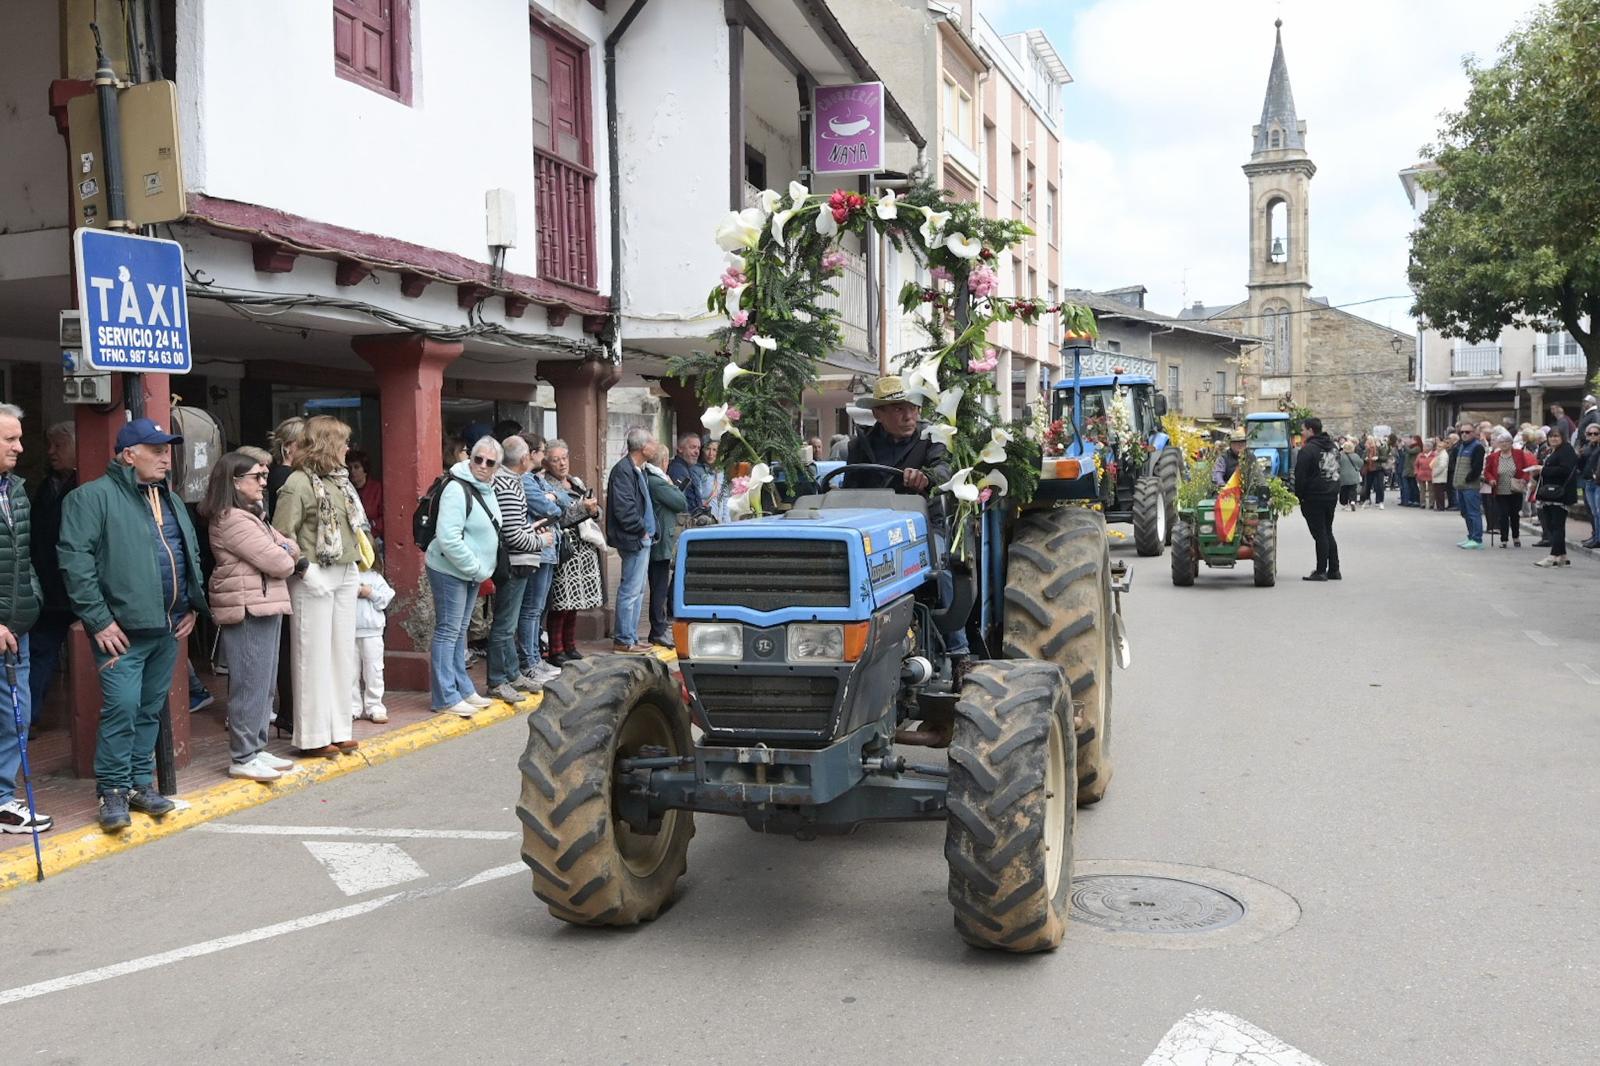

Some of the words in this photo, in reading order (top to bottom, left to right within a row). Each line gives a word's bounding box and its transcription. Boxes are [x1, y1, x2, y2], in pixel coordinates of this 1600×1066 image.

[828, 142, 868, 165] NAYA
[91, 277, 181, 328] TAXI
[98, 326, 152, 347] SERVICIO
[156, 330, 169, 348] 24
[171, 331, 183, 349] H.
[100, 348, 128, 363] TFNO.
[130, 349, 146, 364] 987
[148, 350, 160, 364] 54
[161, 351, 172, 364] 63
[173, 352, 184, 365] 00
